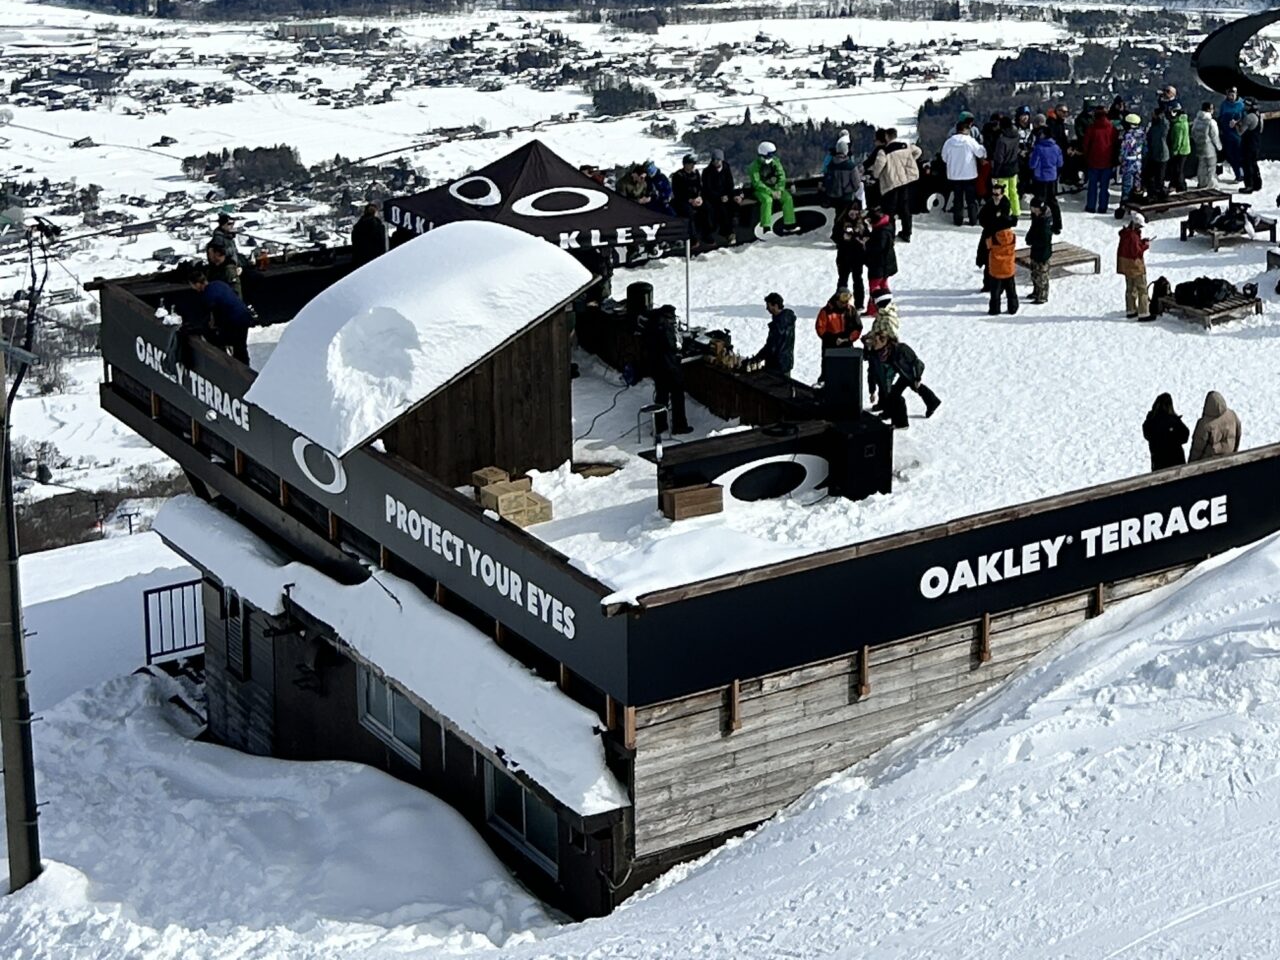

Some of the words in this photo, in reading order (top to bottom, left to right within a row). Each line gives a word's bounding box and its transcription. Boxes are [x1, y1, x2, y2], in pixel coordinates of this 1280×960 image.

[190, 370, 250, 431] TERRACE
[1081, 495, 1227, 558] TERRACE
[385, 494, 464, 567] PROTECT
[467, 543, 523, 606] YOUR
[527, 581, 576, 639] EYES
